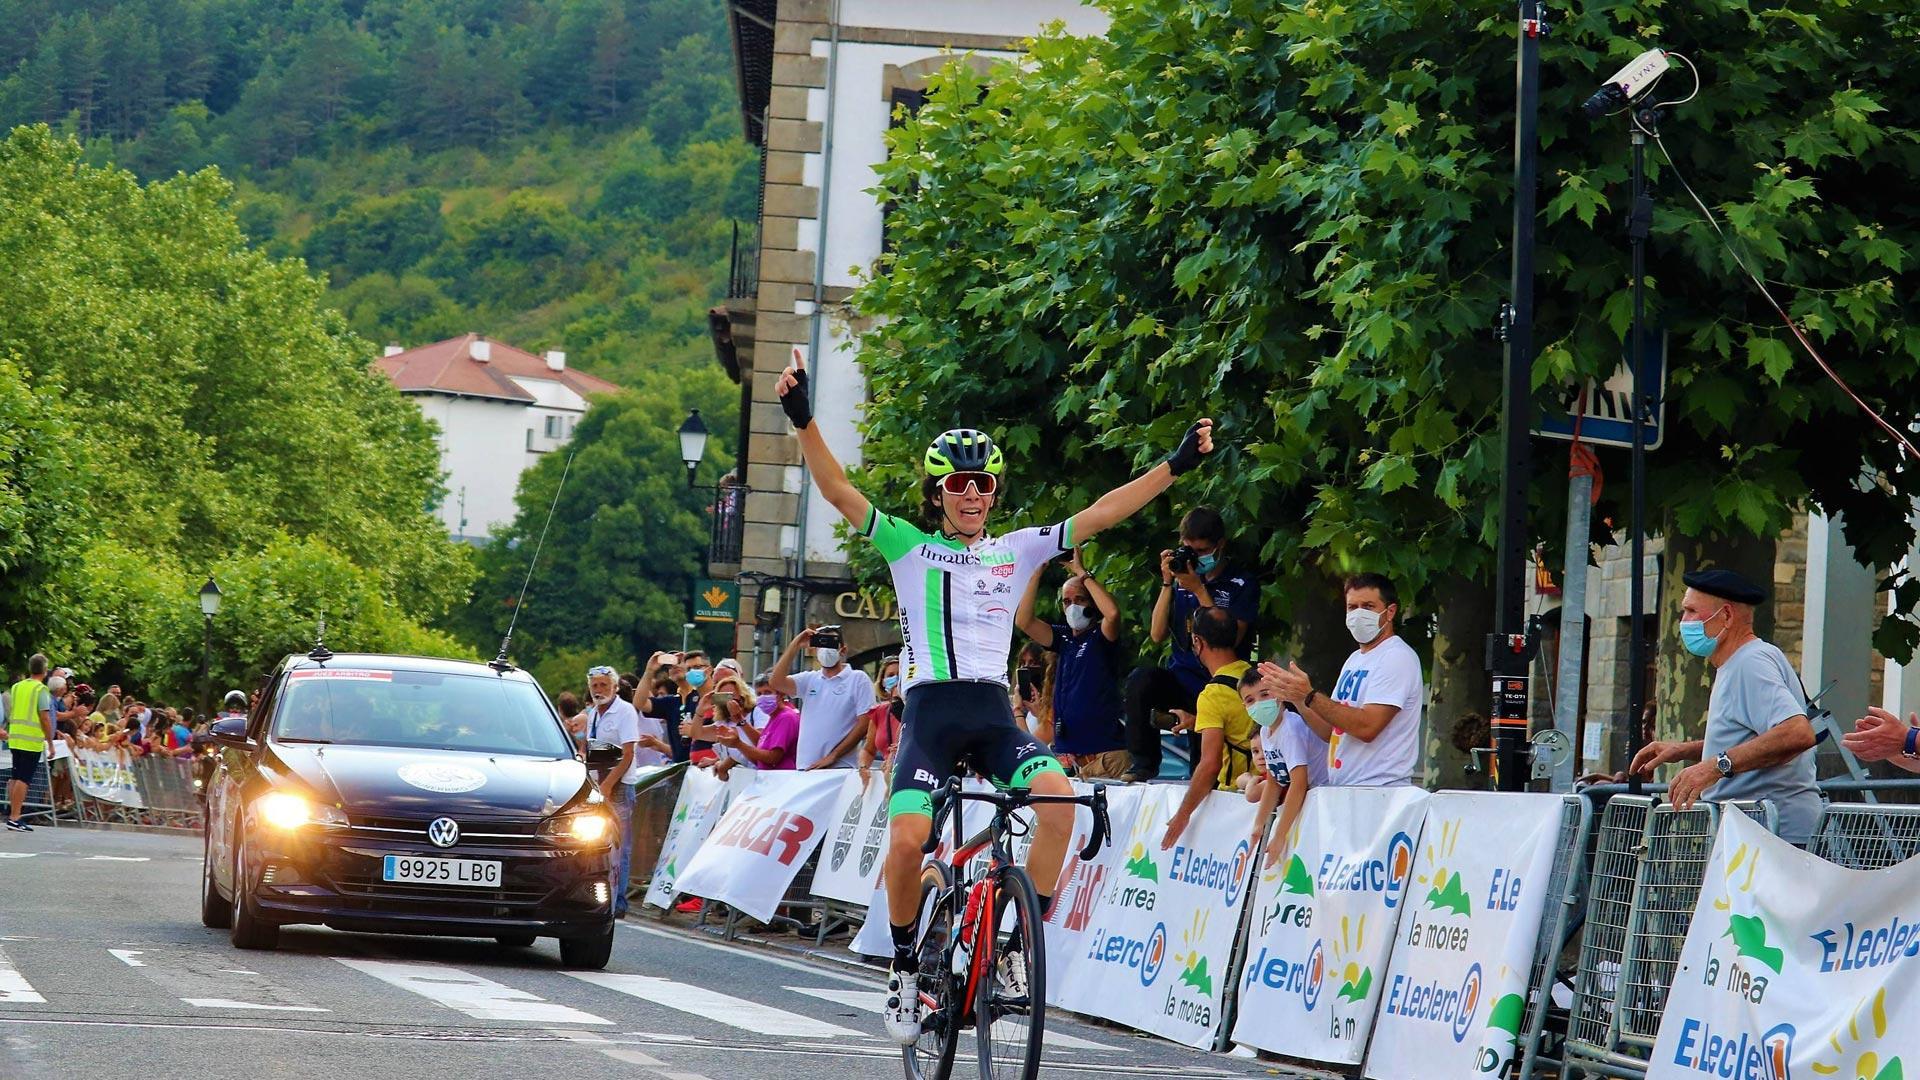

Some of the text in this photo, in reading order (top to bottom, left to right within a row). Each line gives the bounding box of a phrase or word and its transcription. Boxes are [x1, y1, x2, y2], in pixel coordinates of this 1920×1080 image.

[1632, 61, 1657, 82] LYNX
[900, 607, 915, 664] INVERSE
[913, 768, 939, 788] BH
[1021, 760, 1048, 779] BH
[399, 859, 450, 880] 9925
[458, 862, 496, 882] LBG
[1169, 846, 1229, 890] E.Leclerc
[1407, 911, 1469, 951] la morea
[1703, 942, 1720, 986] la
[1163, 985, 1210, 1028] la morea
[1386, 974, 1457, 1023] E.Leclerc
[1330, 1005, 1340, 1039] la
[1674, 1018, 1764, 1080] E.Lecle
